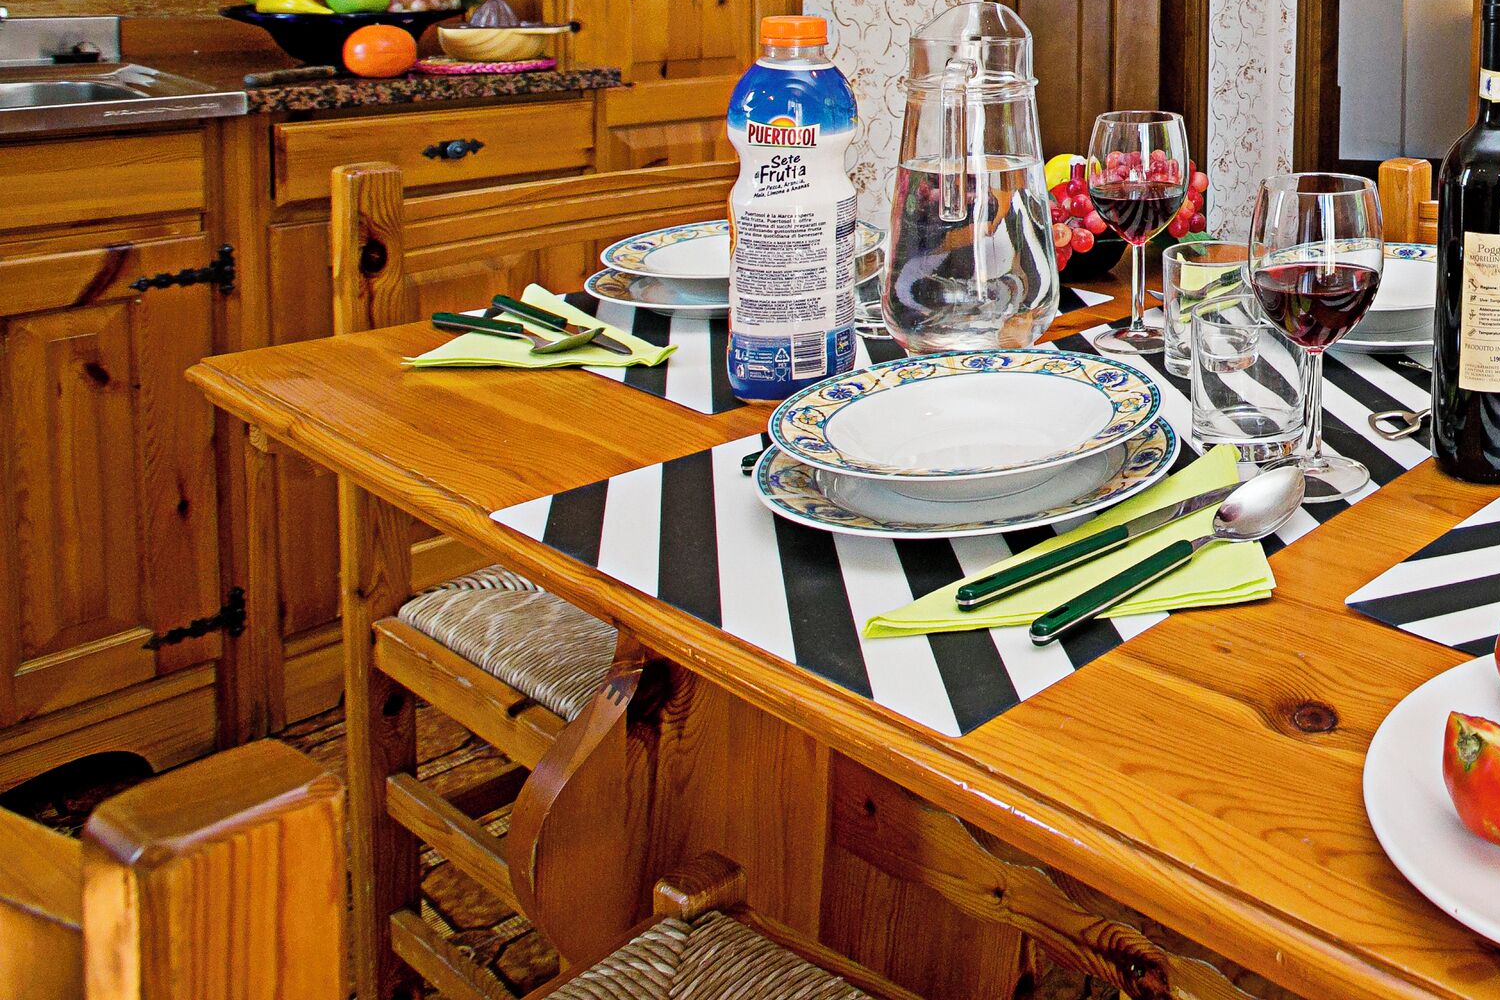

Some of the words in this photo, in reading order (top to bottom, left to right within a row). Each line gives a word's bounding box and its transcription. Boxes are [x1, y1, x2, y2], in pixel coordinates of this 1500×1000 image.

[748, 124, 816, 146] PUERTOSOL
[771, 155, 800, 169] Sete
[760, 165, 806, 184] Frutta
